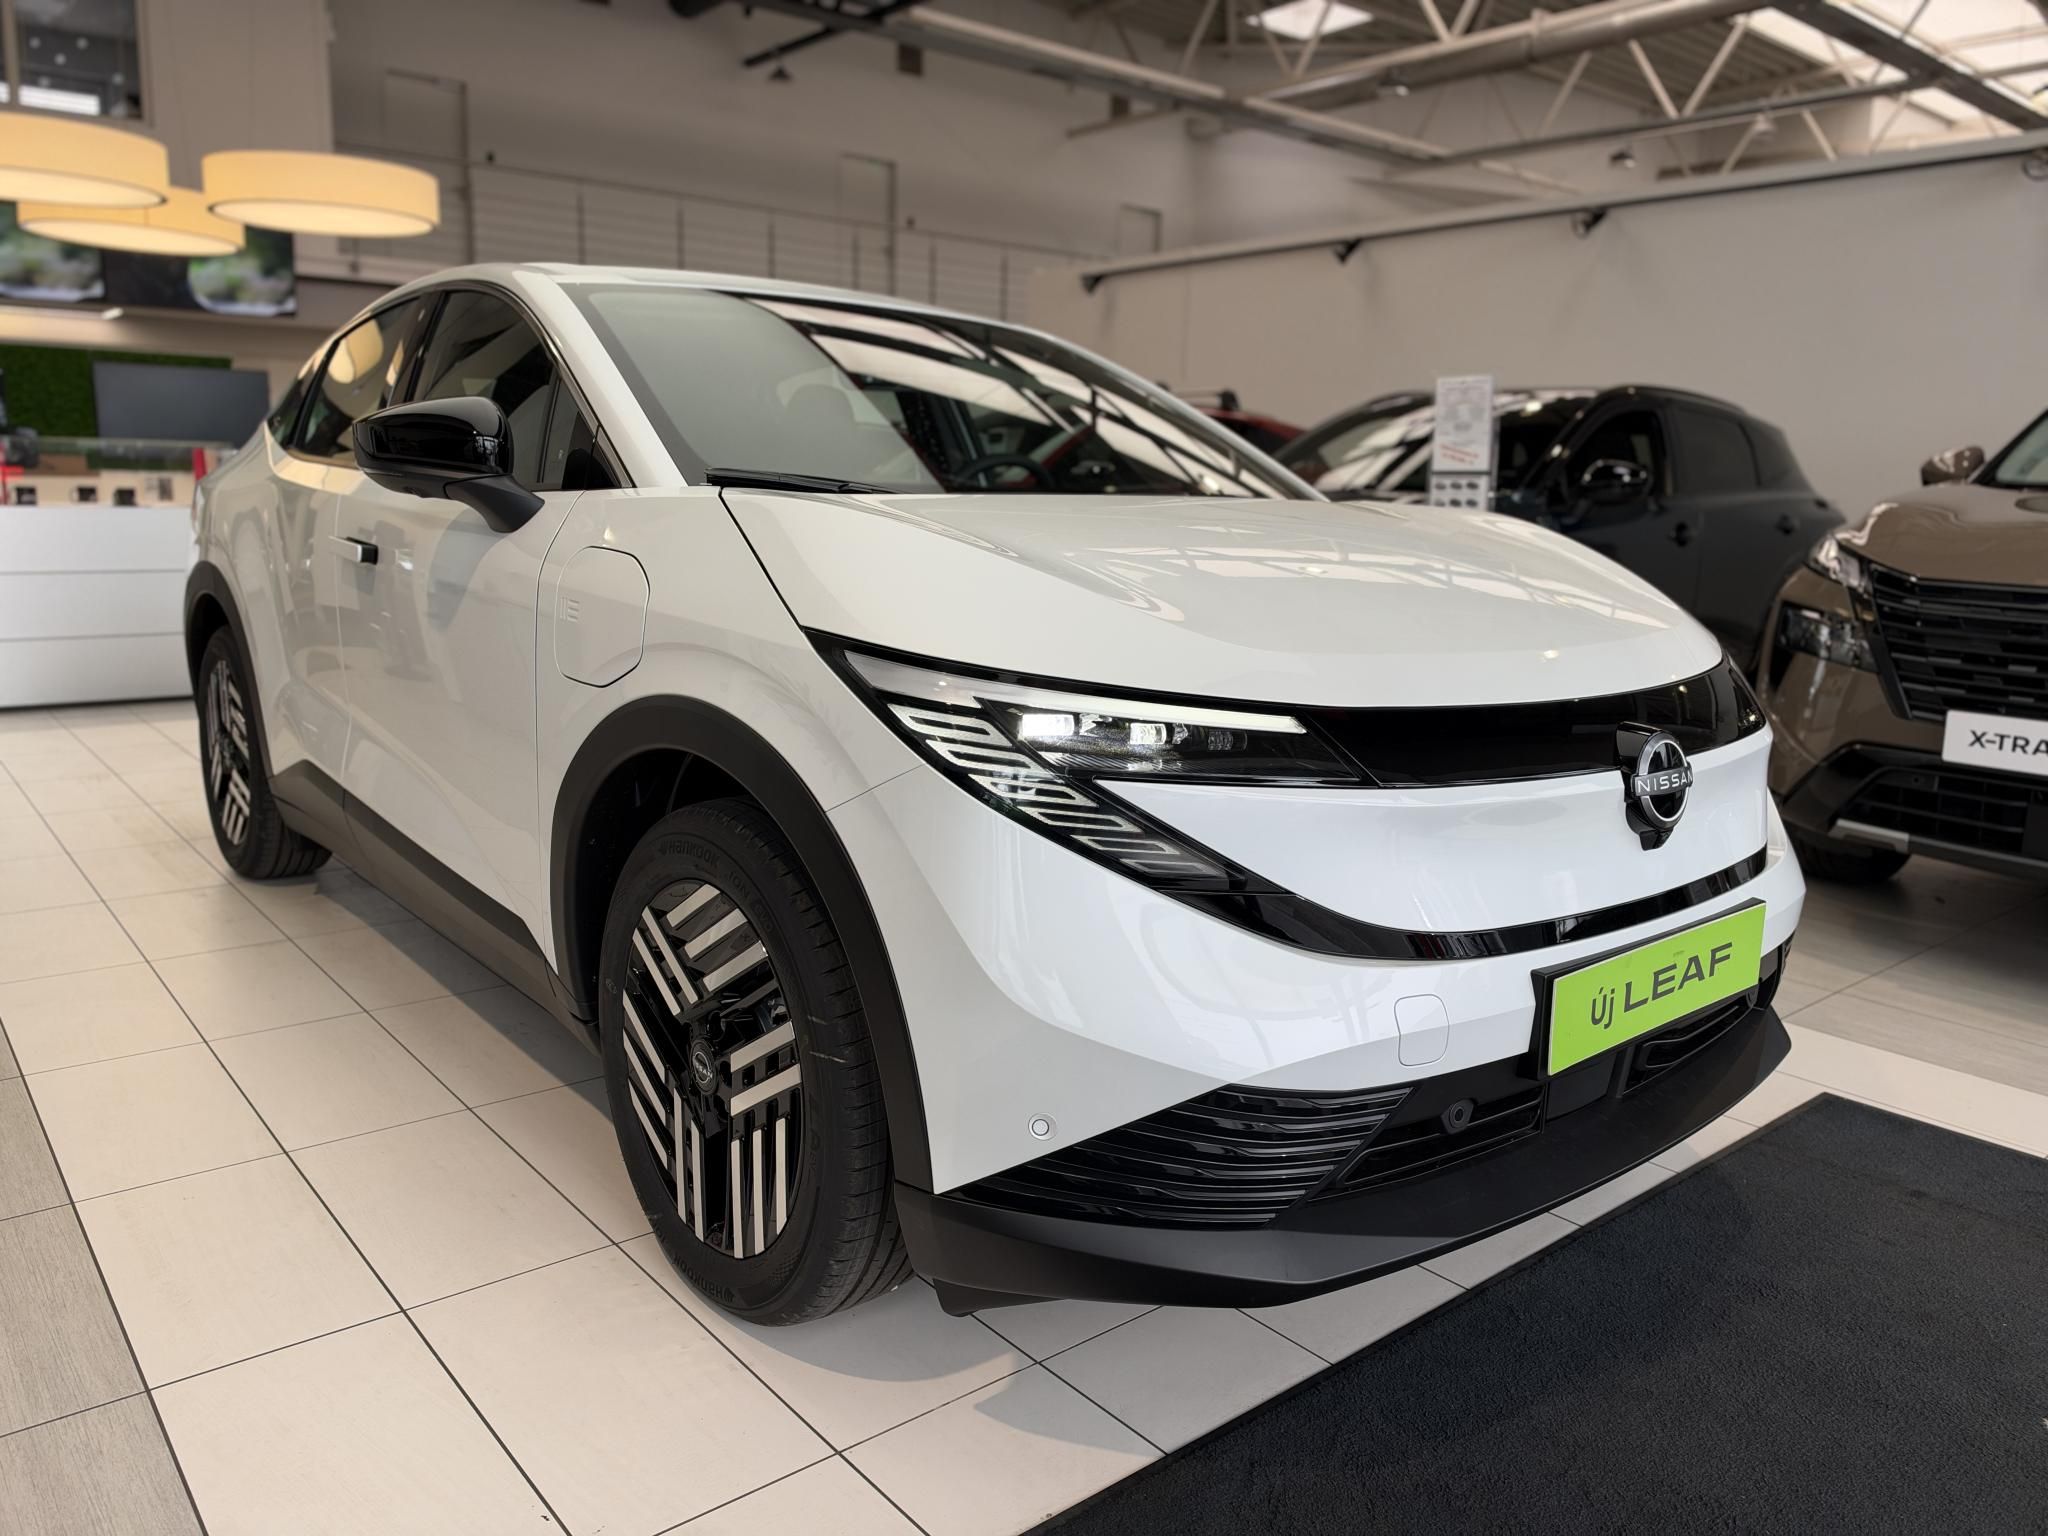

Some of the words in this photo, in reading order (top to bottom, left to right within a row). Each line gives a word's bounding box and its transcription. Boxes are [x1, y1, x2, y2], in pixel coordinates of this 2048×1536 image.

[1968, 729, 2048, 757] X-TRA
[1637, 769, 1693, 793] NISSAN
[1623, 942, 1733, 1013] LEAF
